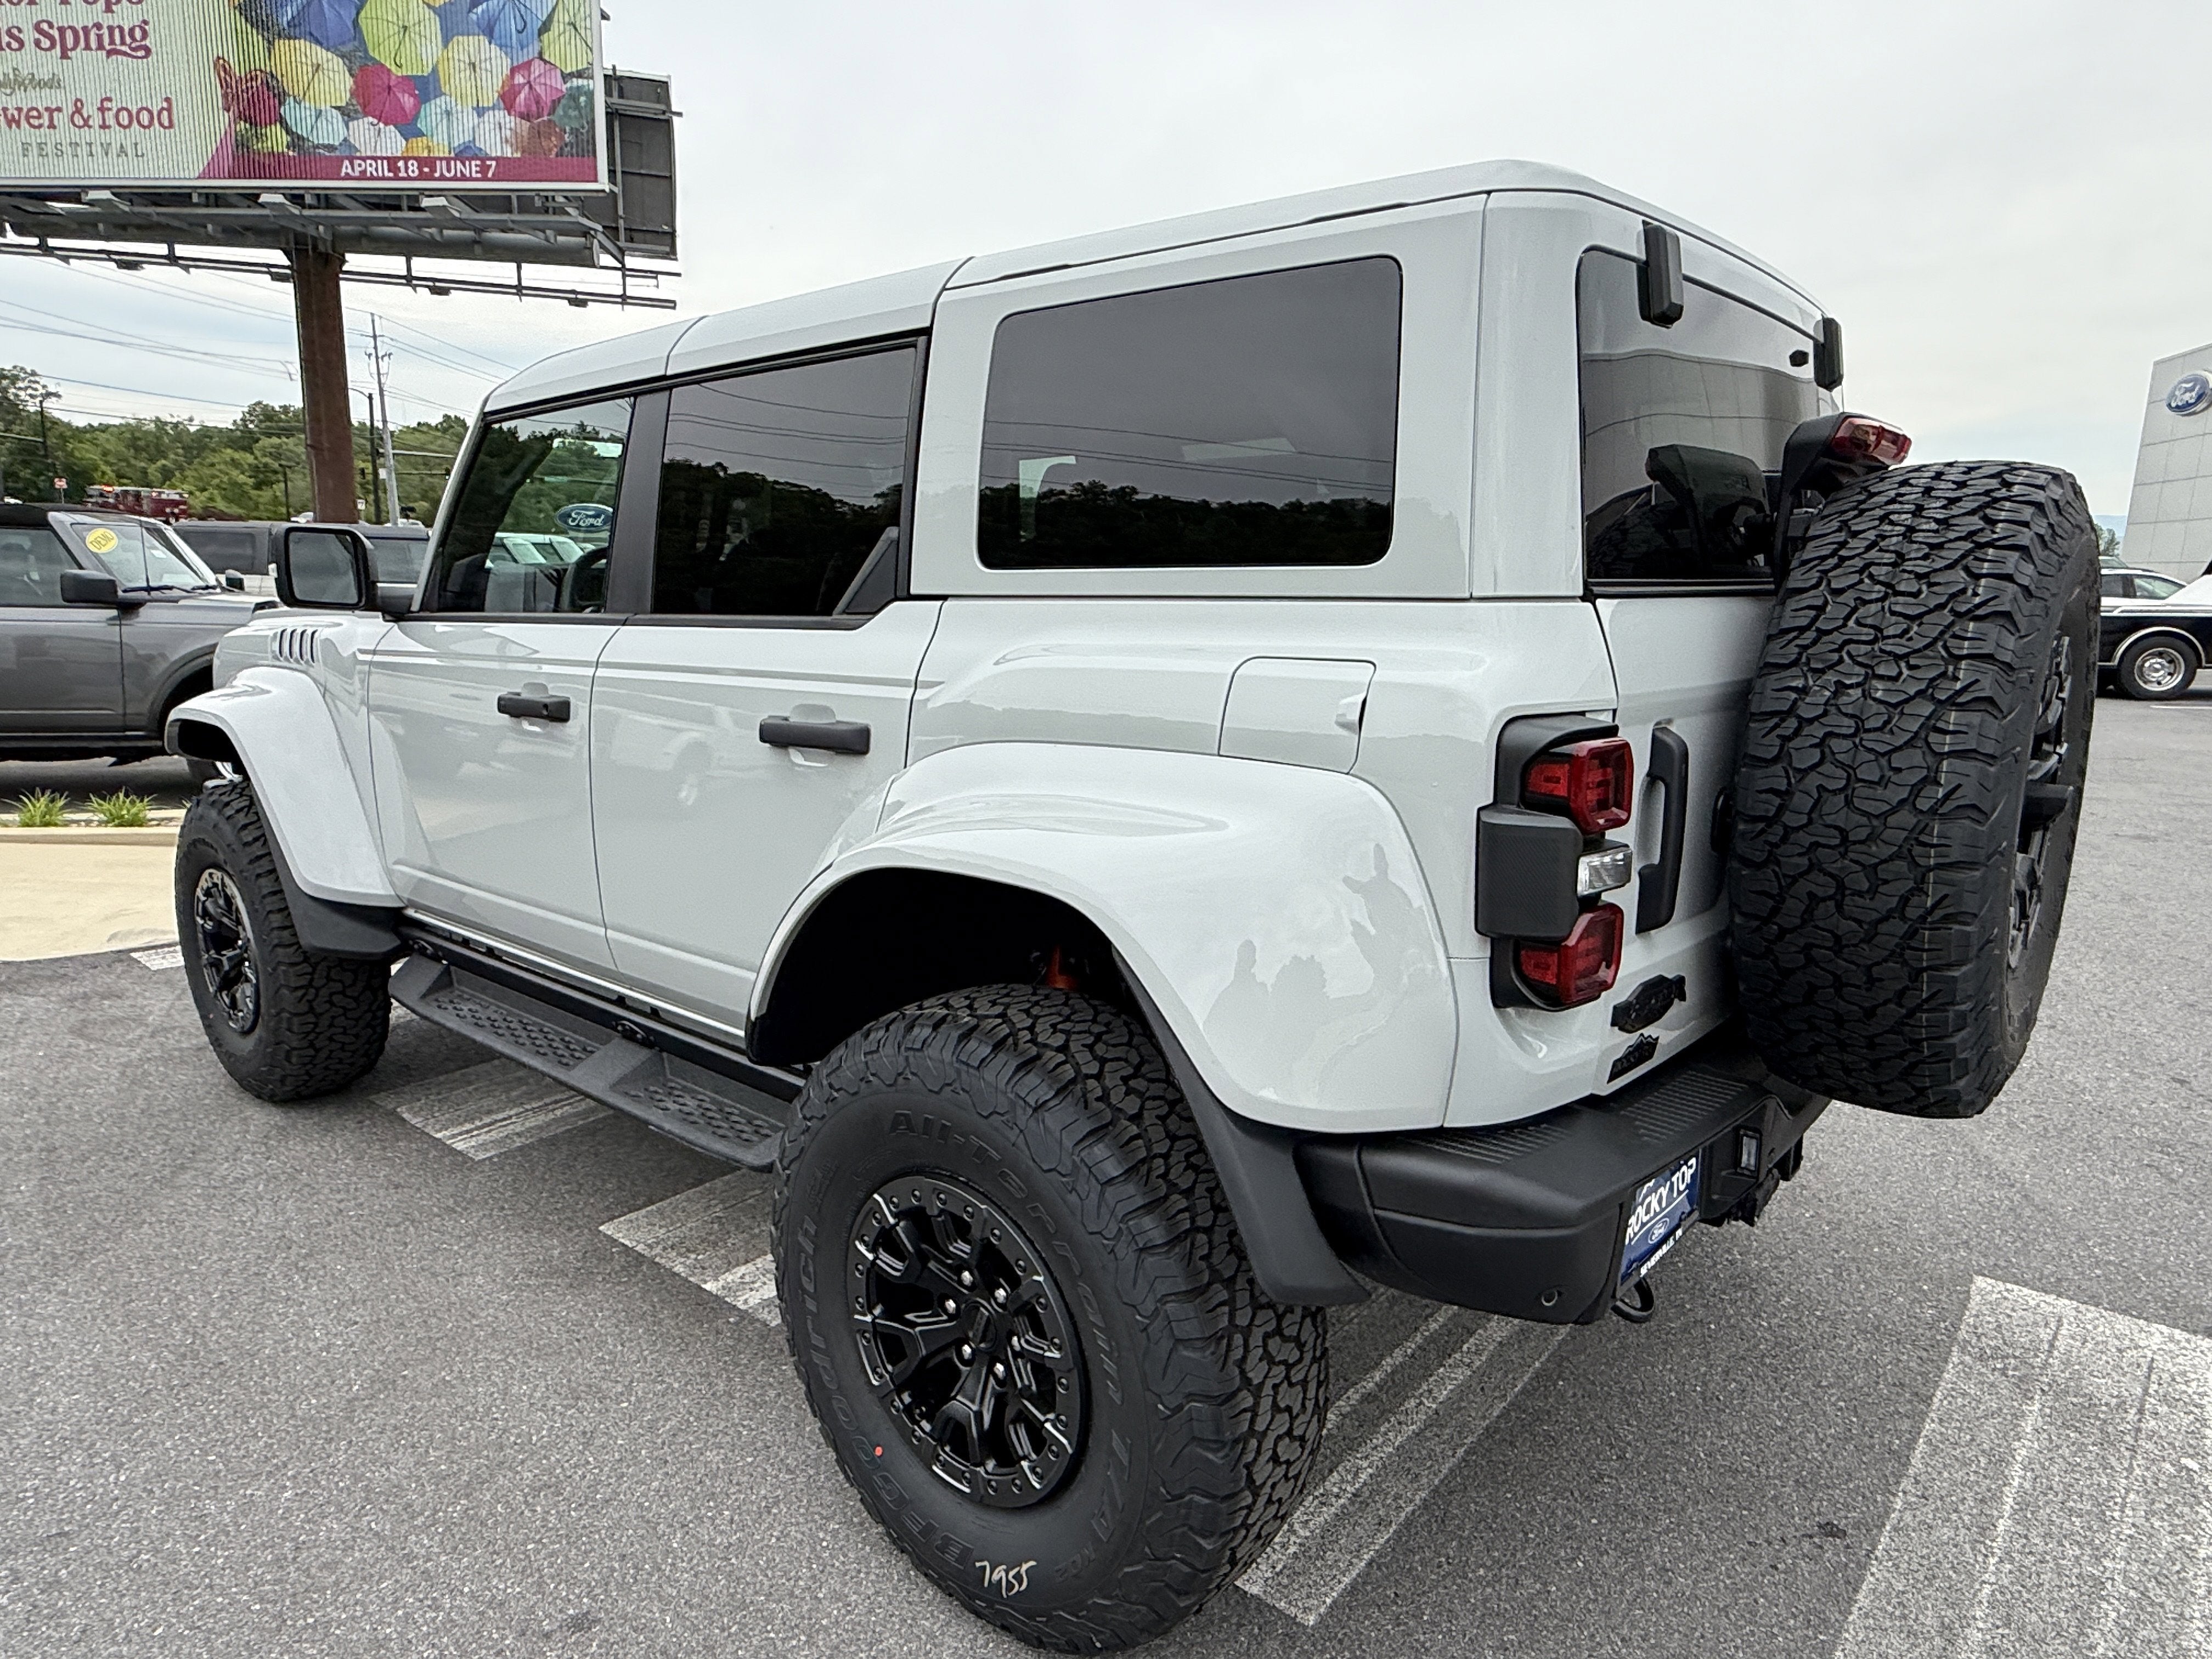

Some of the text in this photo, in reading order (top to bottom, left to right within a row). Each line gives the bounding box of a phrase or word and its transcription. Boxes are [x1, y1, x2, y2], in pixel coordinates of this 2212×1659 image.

[33, 19, 152, 60] Spring
[0, 97, 174, 131] wer & food
[21, 141, 145, 158] FESTIVAL
[340, 159, 393, 177] APRIL
[397, 160, 419, 177] 18
[434, 160, 482, 178] JUNE
[486, 160, 496, 178] 7
[2170, 381, 2201, 408] Ford
[567, 509, 605, 527] Ford
[89, 531, 114, 551] DEMO
[1625, 1156, 1697, 1245] ROCKY TOP
[975, 1560, 1037, 1599] 7955
